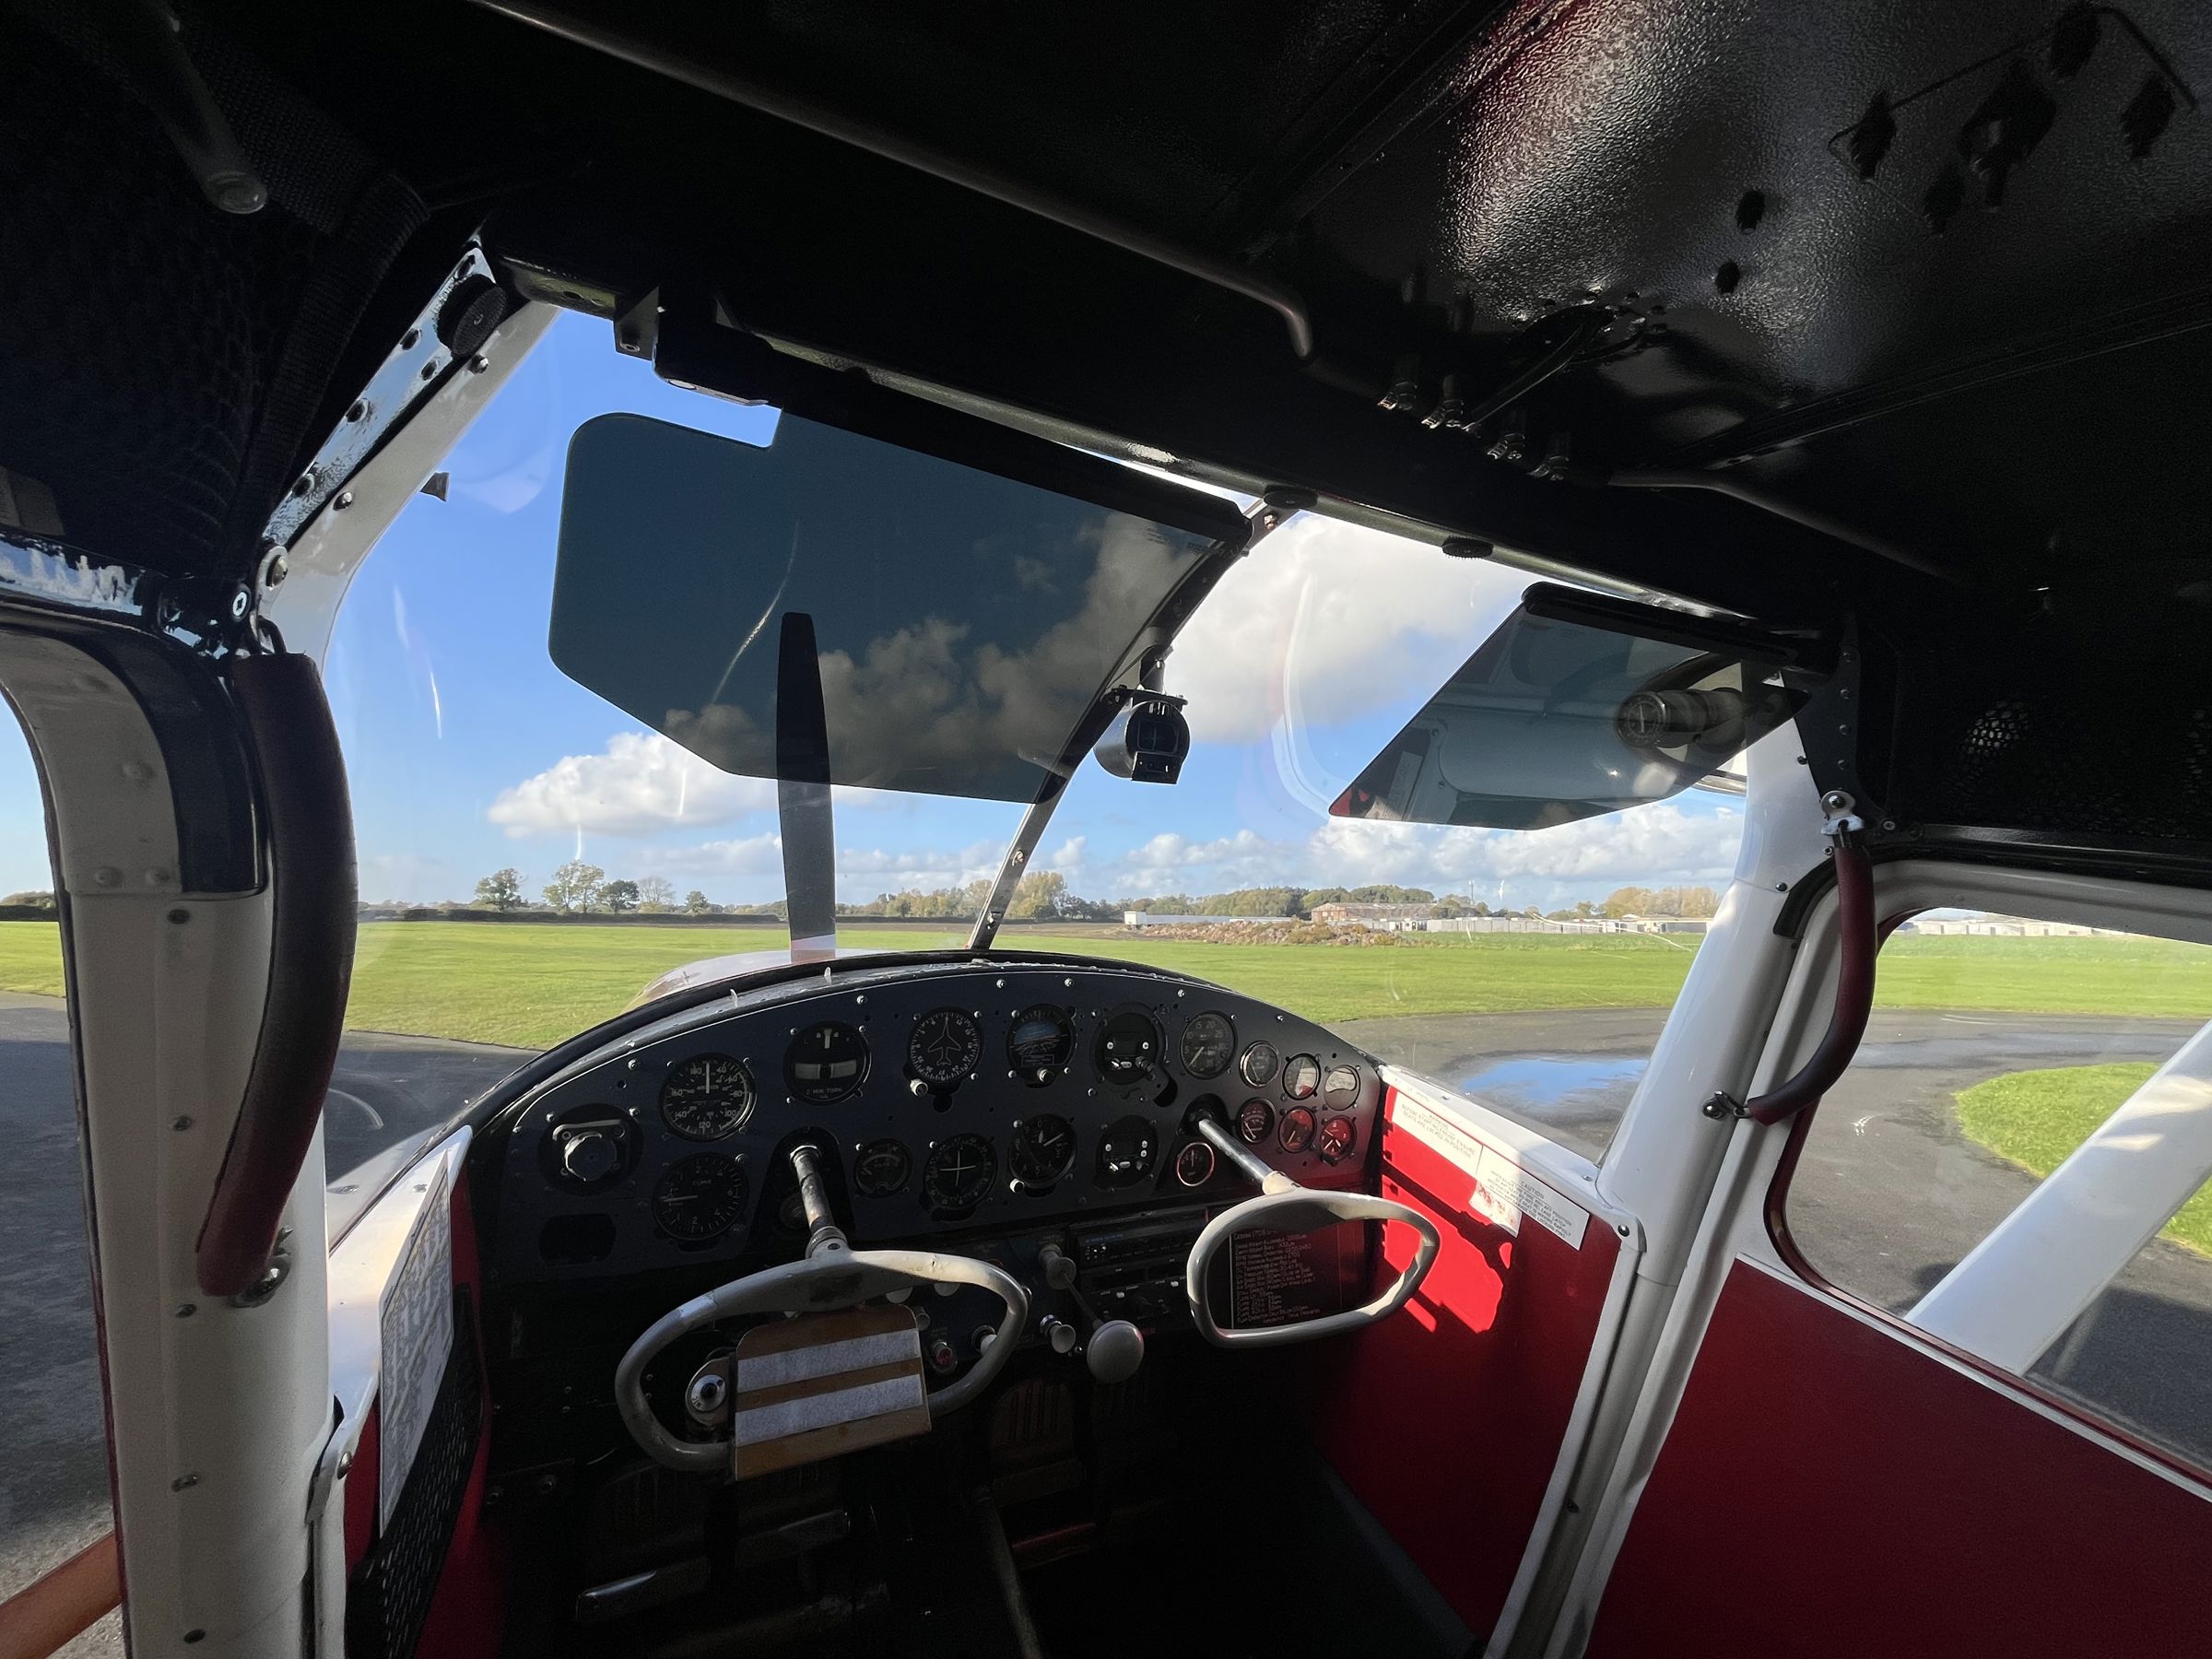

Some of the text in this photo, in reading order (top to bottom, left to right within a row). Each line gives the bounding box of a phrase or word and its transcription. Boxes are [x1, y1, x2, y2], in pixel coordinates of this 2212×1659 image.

[693, 1165, 701, 1174] 2
[1521, 1181, 1546, 1199] CAUTION
[1553, 1222, 1571, 1237] RAPIDLY
[691, 1395, 701, 1408] MIC
